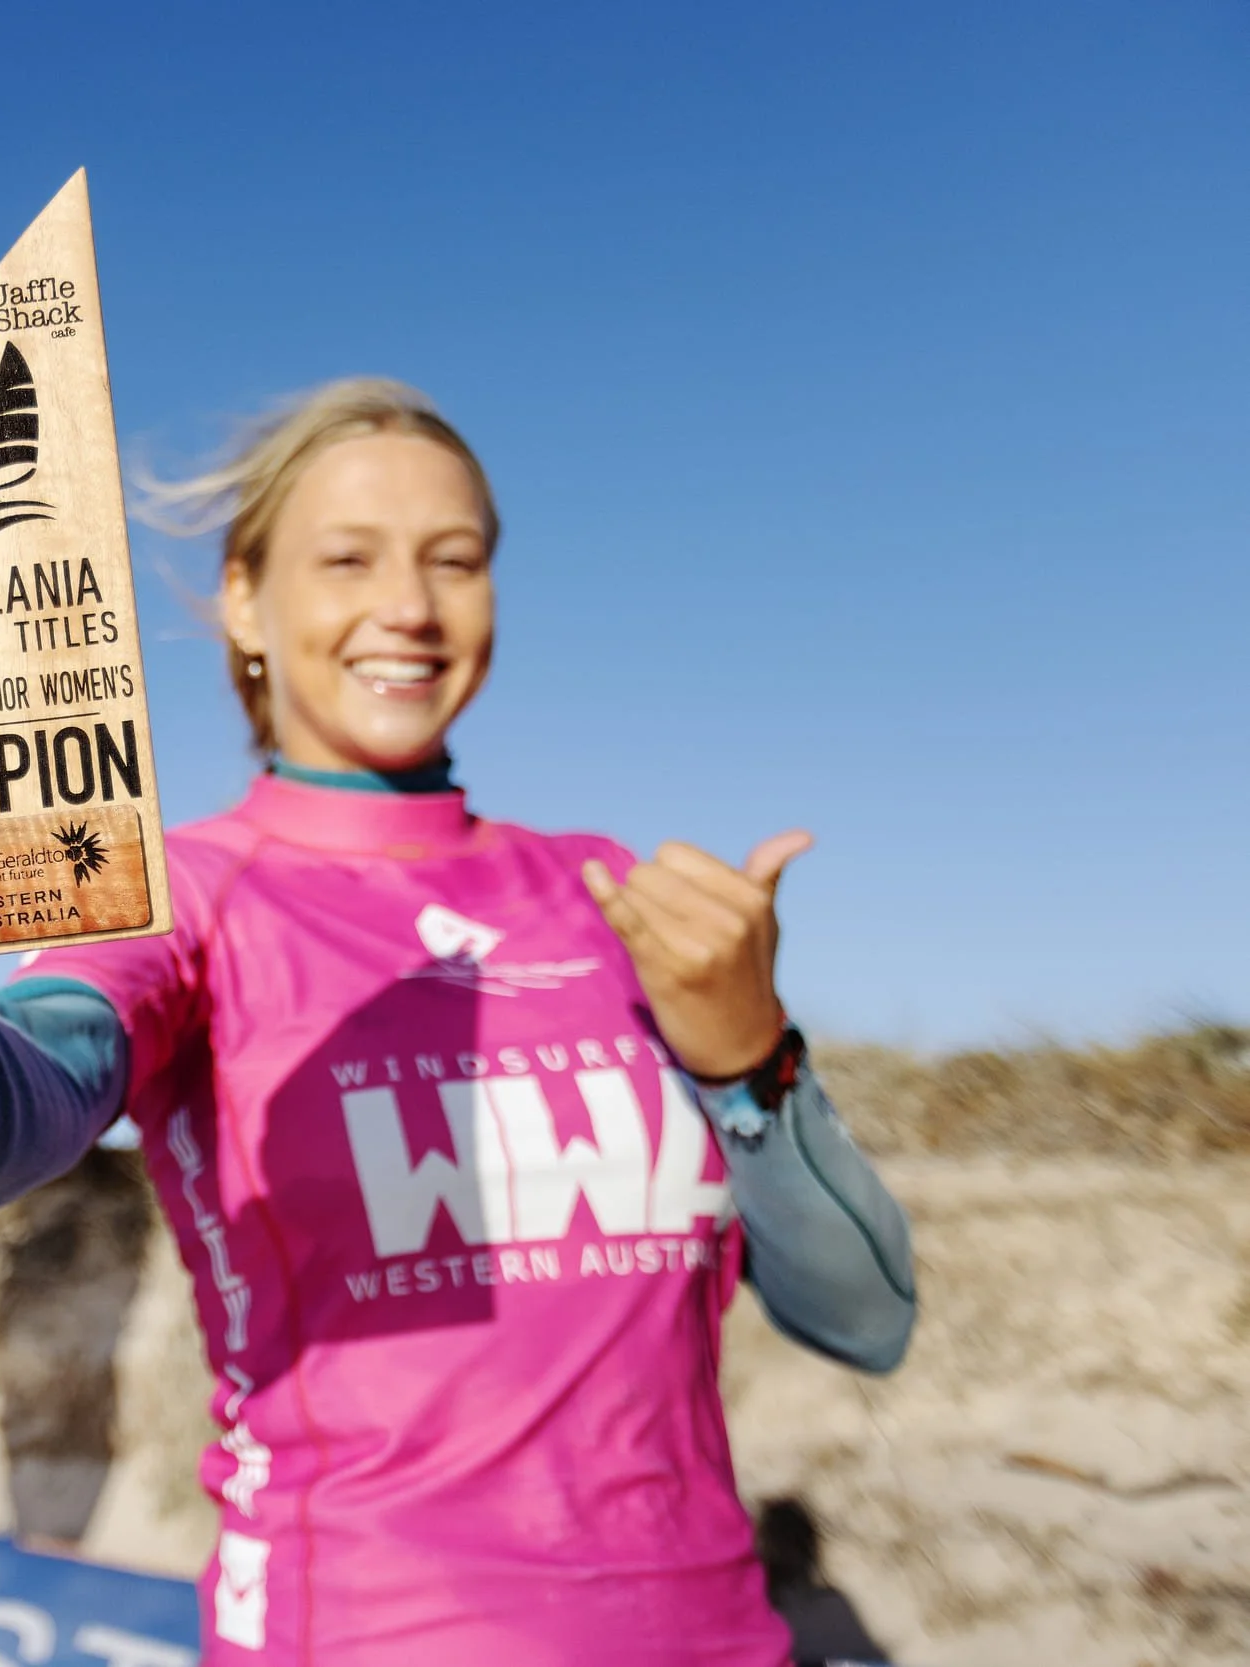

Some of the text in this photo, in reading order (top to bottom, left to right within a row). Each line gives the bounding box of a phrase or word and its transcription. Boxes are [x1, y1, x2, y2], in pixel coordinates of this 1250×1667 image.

[51, 327, 76, 338] cafe
[14, 611, 119, 653] TITLES
[40, 664, 134, 708] WOMEN'S
[9, 867, 44, 880] future
[345, 1245, 562, 1303] WESTERN
